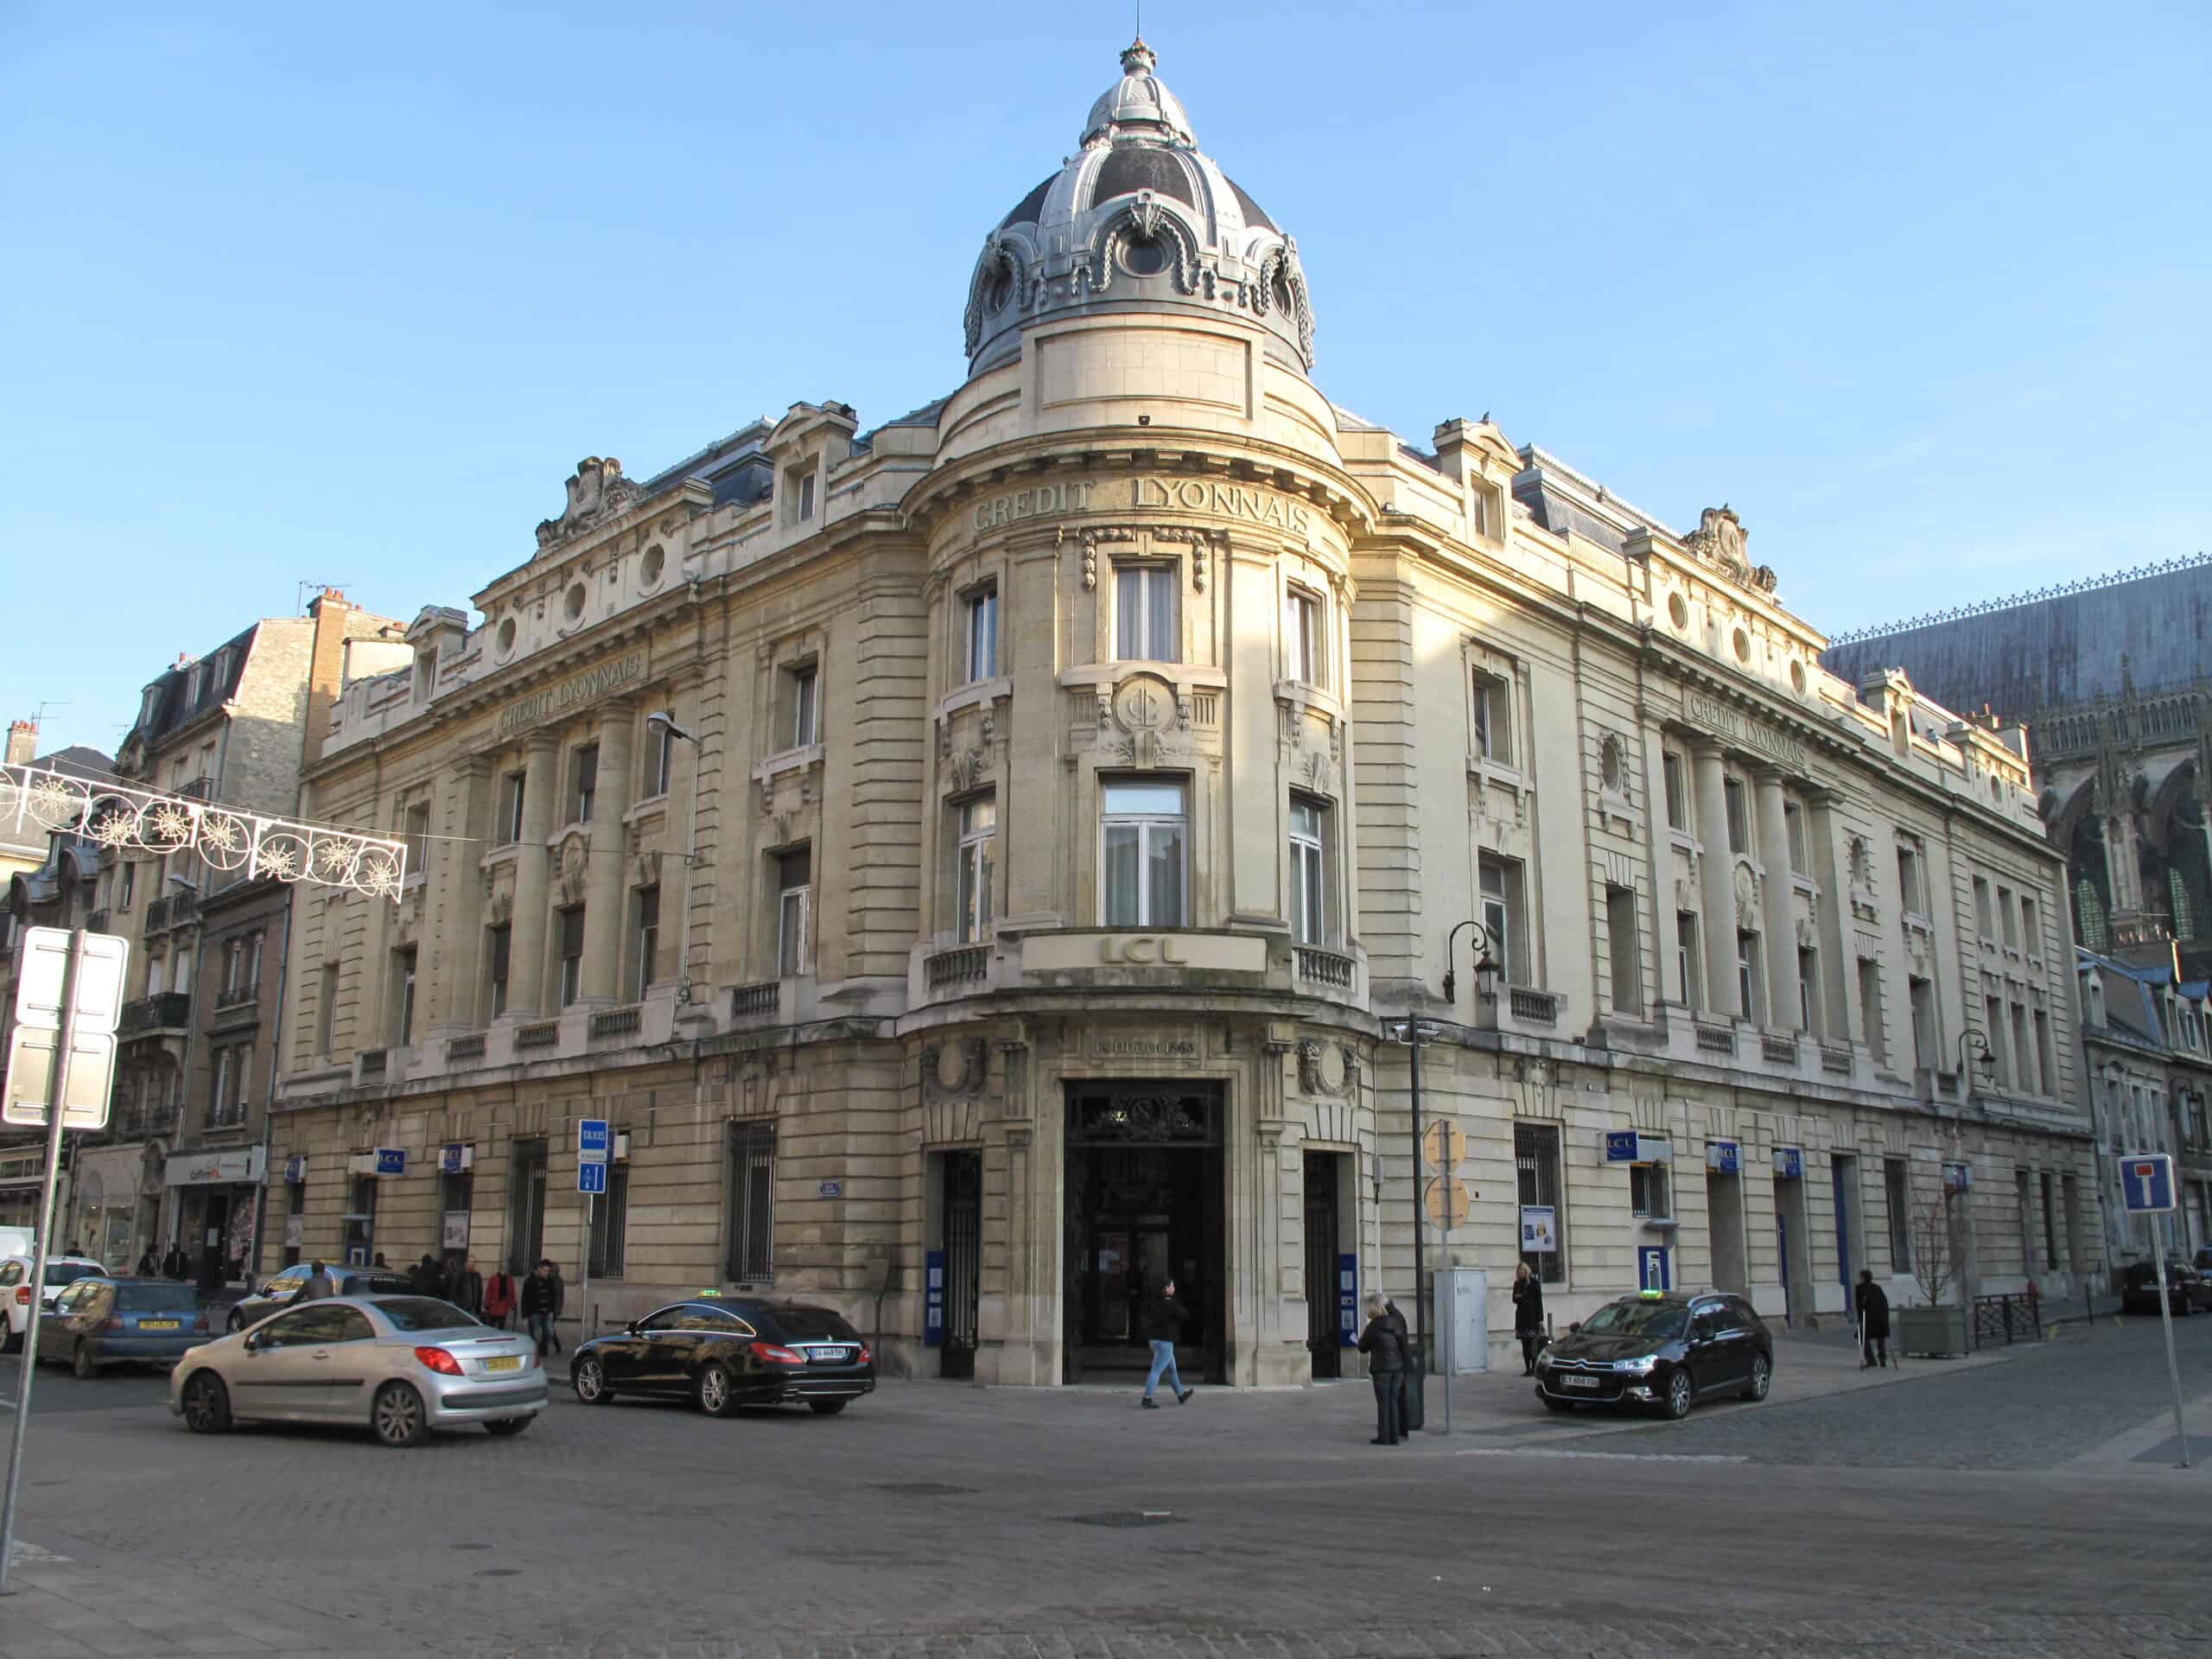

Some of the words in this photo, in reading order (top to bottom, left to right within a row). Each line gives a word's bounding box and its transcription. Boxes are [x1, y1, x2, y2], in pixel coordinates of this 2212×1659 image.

[973, 480, 1095, 531] CREDIT
[1133, 477, 1310, 534] LYONNAIS
[558, 655, 640, 706] LYONNAIS
[1690, 696, 1738, 734] CREDIT
[1745, 717, 1805, 765] LYONNAIS
[1100, 938, 1190, 964] LCL
[583, 1129, 605, 1141] TAXIS
[1606, 1137, 1632, 1148] LCL
[378, 1154, 401, 1163] LCL
[1718, 1146, 1736, 1159] LCL
